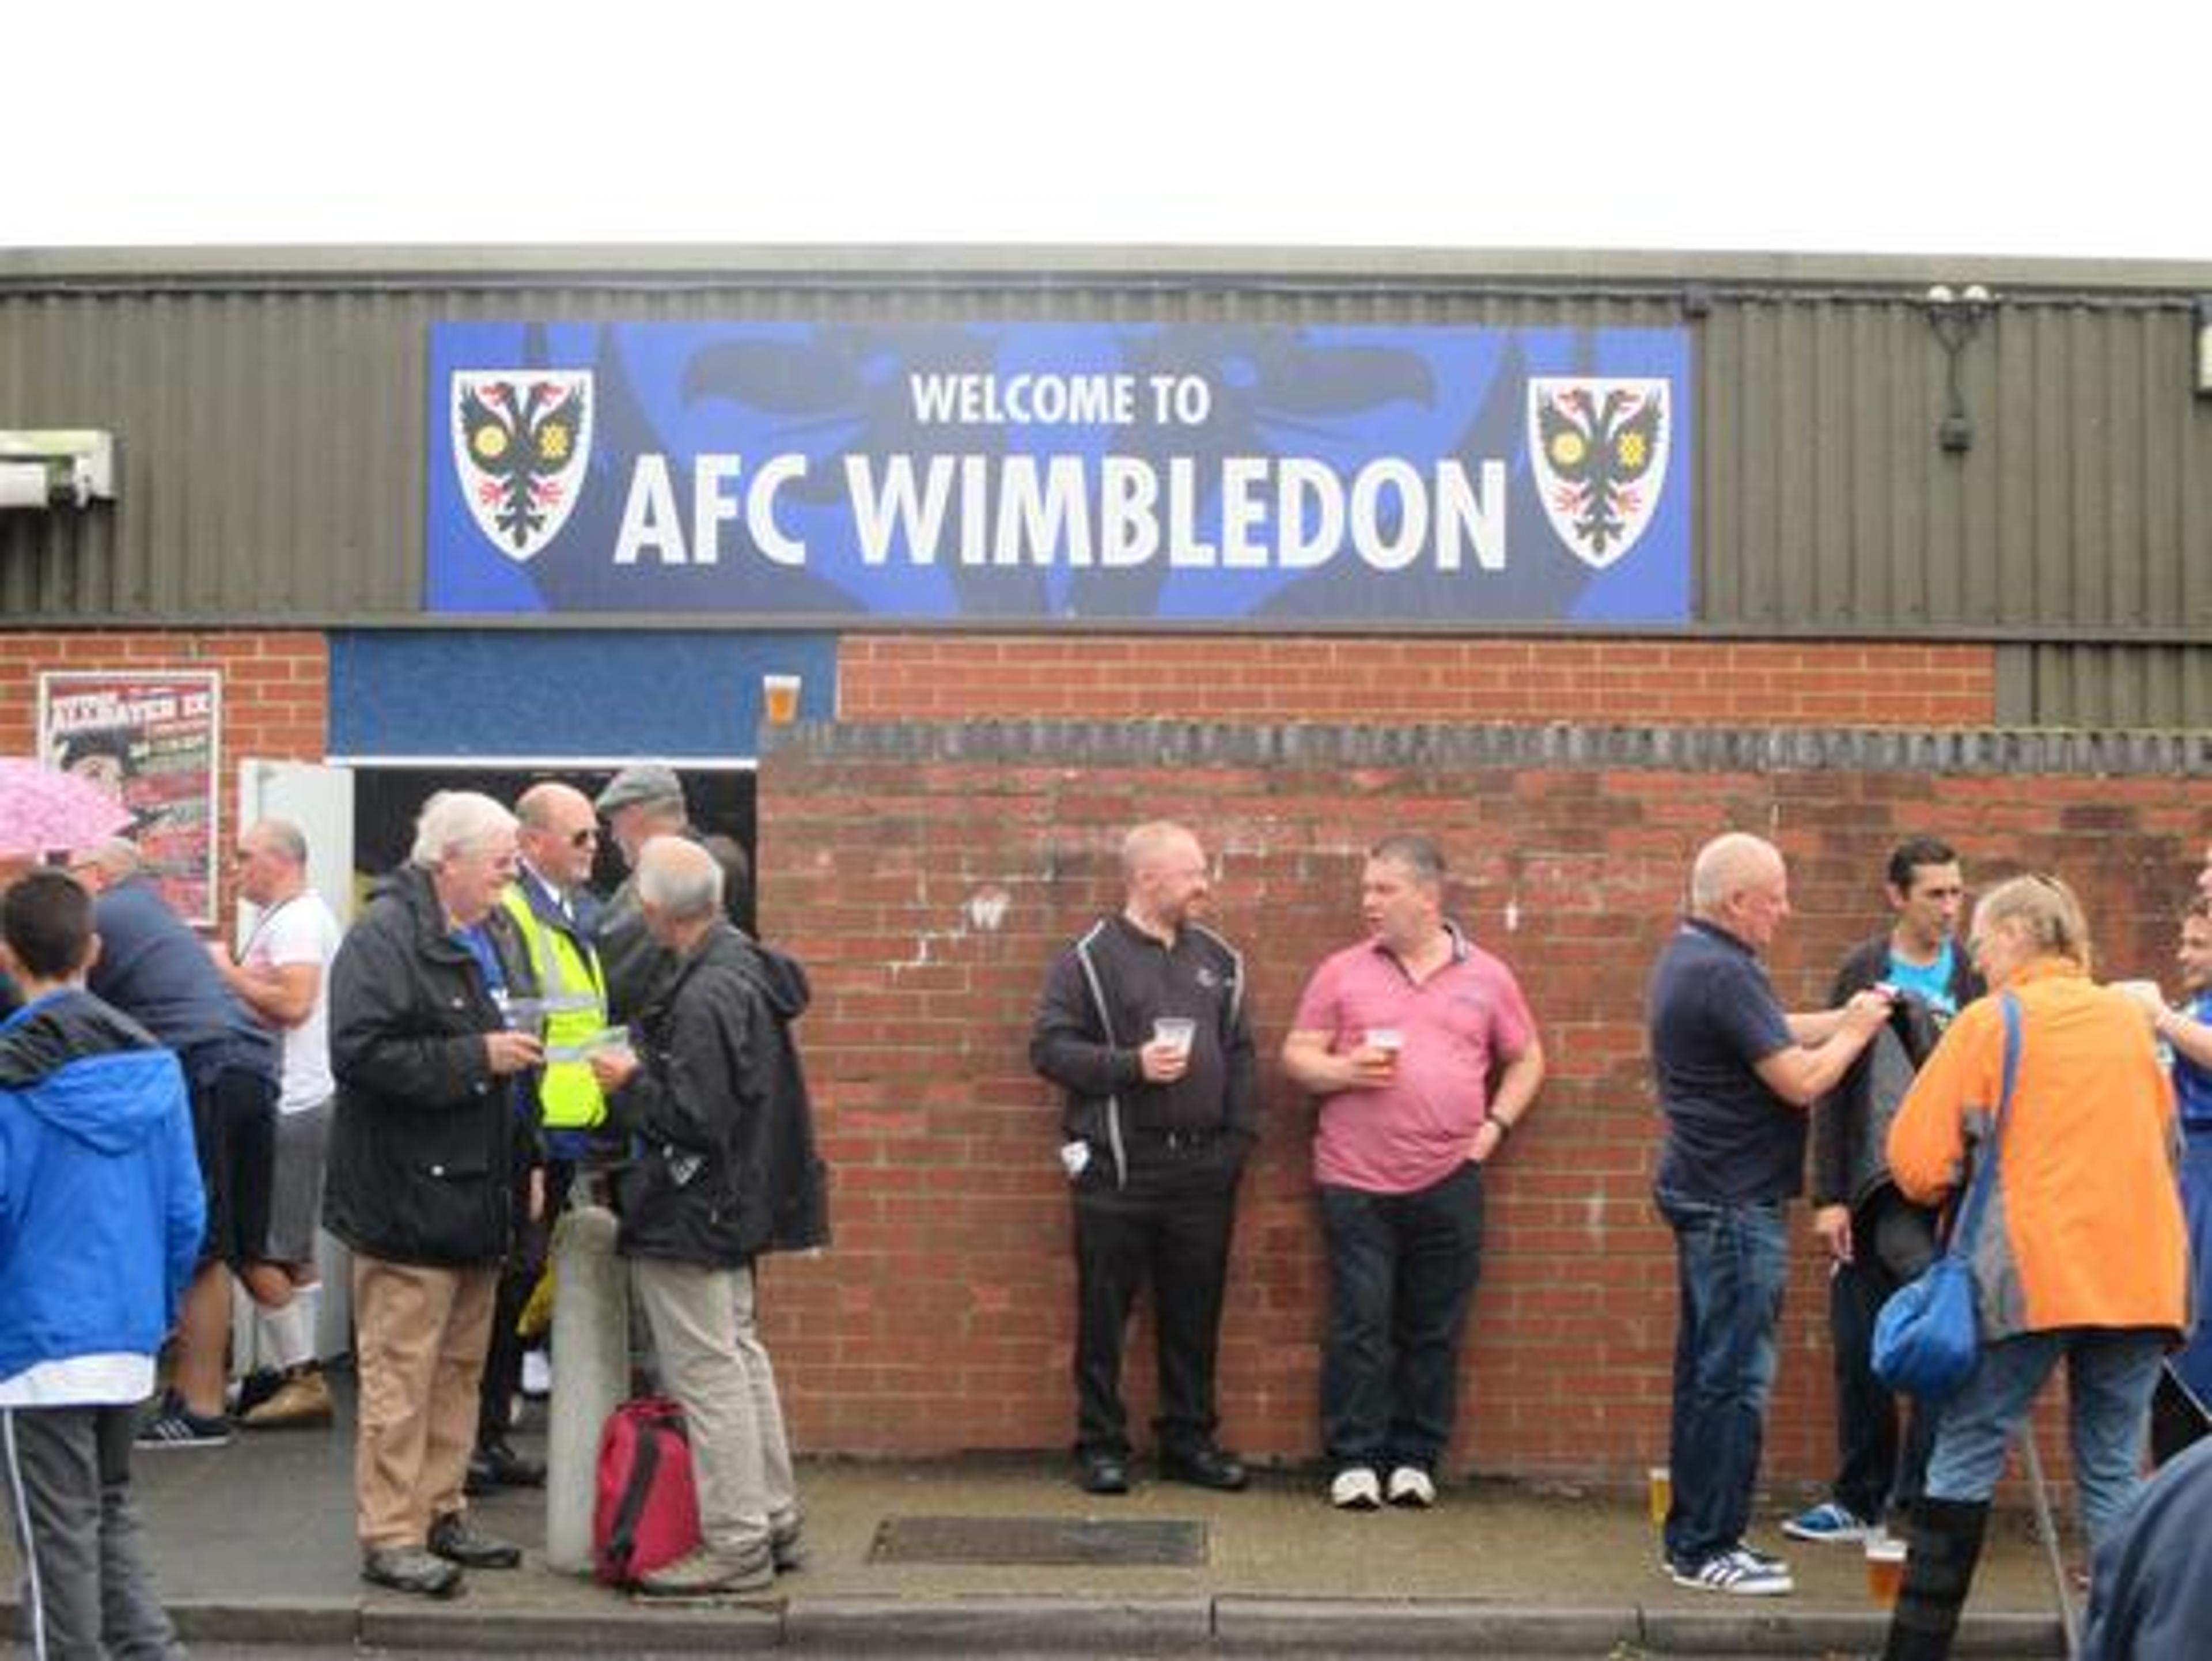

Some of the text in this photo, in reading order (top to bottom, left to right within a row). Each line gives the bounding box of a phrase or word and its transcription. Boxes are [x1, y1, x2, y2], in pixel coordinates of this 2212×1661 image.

[910, 373, 1210, 424] WELCOME TO
[613, 453, 1508, 569] AFC WIMBLEDON
